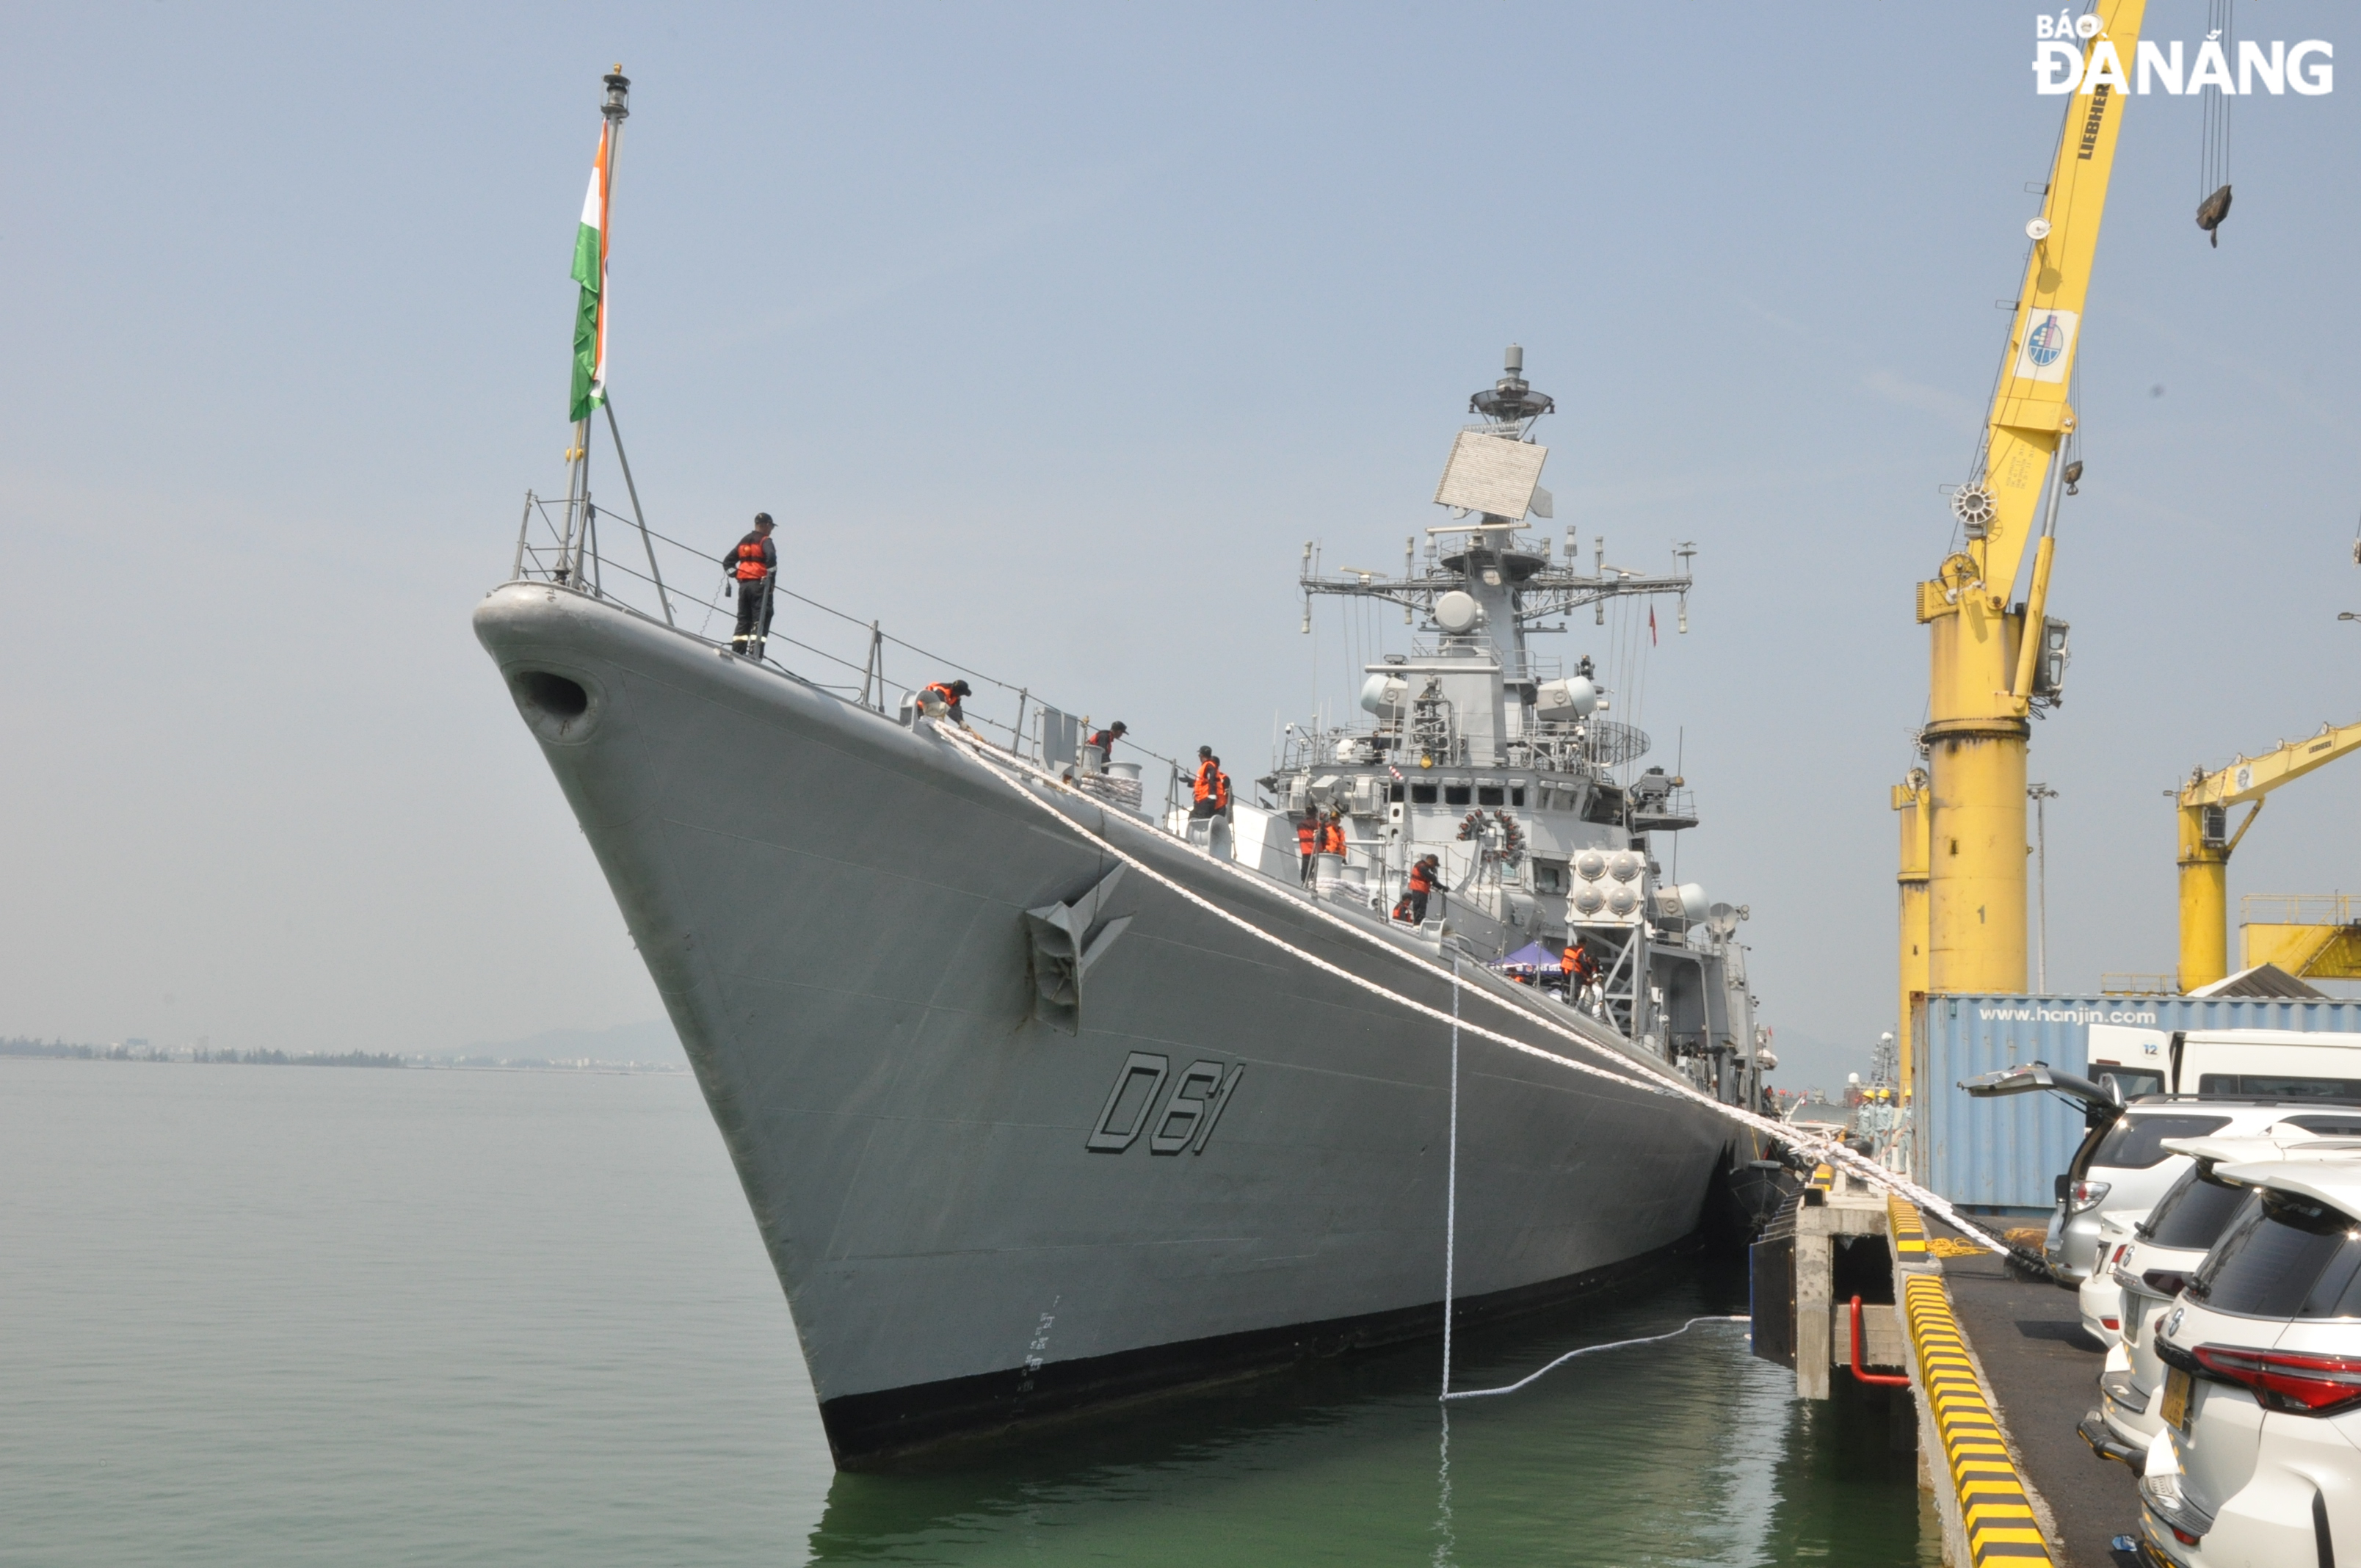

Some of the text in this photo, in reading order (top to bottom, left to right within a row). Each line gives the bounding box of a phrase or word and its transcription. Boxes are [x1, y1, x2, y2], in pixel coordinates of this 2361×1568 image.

[2078, 70, 2111, 160] LIEBHER
[1976, 904, 1986, 924] 1
[1980, 1006, 2156, 1026] www.hanjin.com
[2143, 1044, 2158, 1055] 12
[1085, 1050, 1247, 1156] D61
